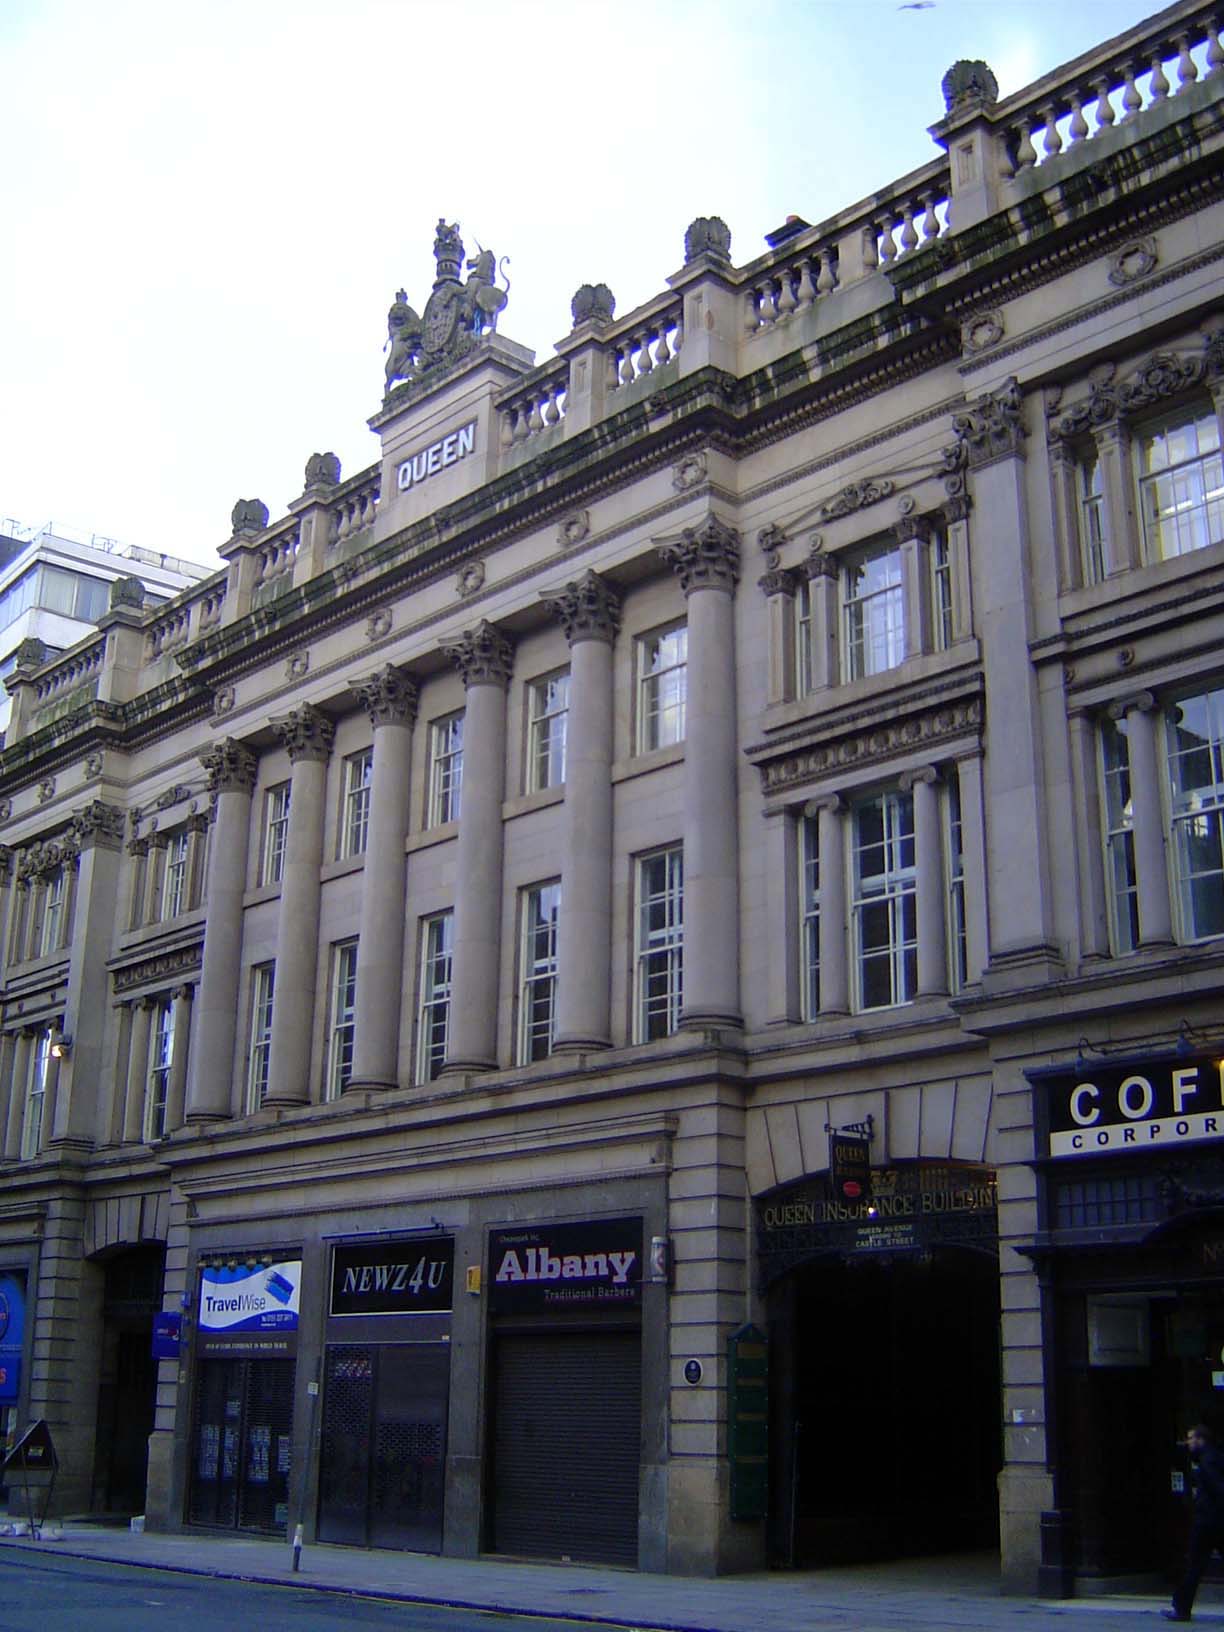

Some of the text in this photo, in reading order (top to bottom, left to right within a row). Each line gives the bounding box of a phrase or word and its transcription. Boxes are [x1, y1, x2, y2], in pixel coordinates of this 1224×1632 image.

[398, 423, 475, 491] QUEEN
[1069, 1060, 1224, 1126] COF
[764, 1187, 998, 1226] QUEEN INSURANCE BUILDIN
[886, 1236, 914, 1246] STREET
[341, 1256, 448, 1294] NEWZ4U
[495, 1247, 636, 1283] Albany
[206, 1294, 265, 1312] TravelWise
[543, 1286, 635, 1299] Traditional Barbers
